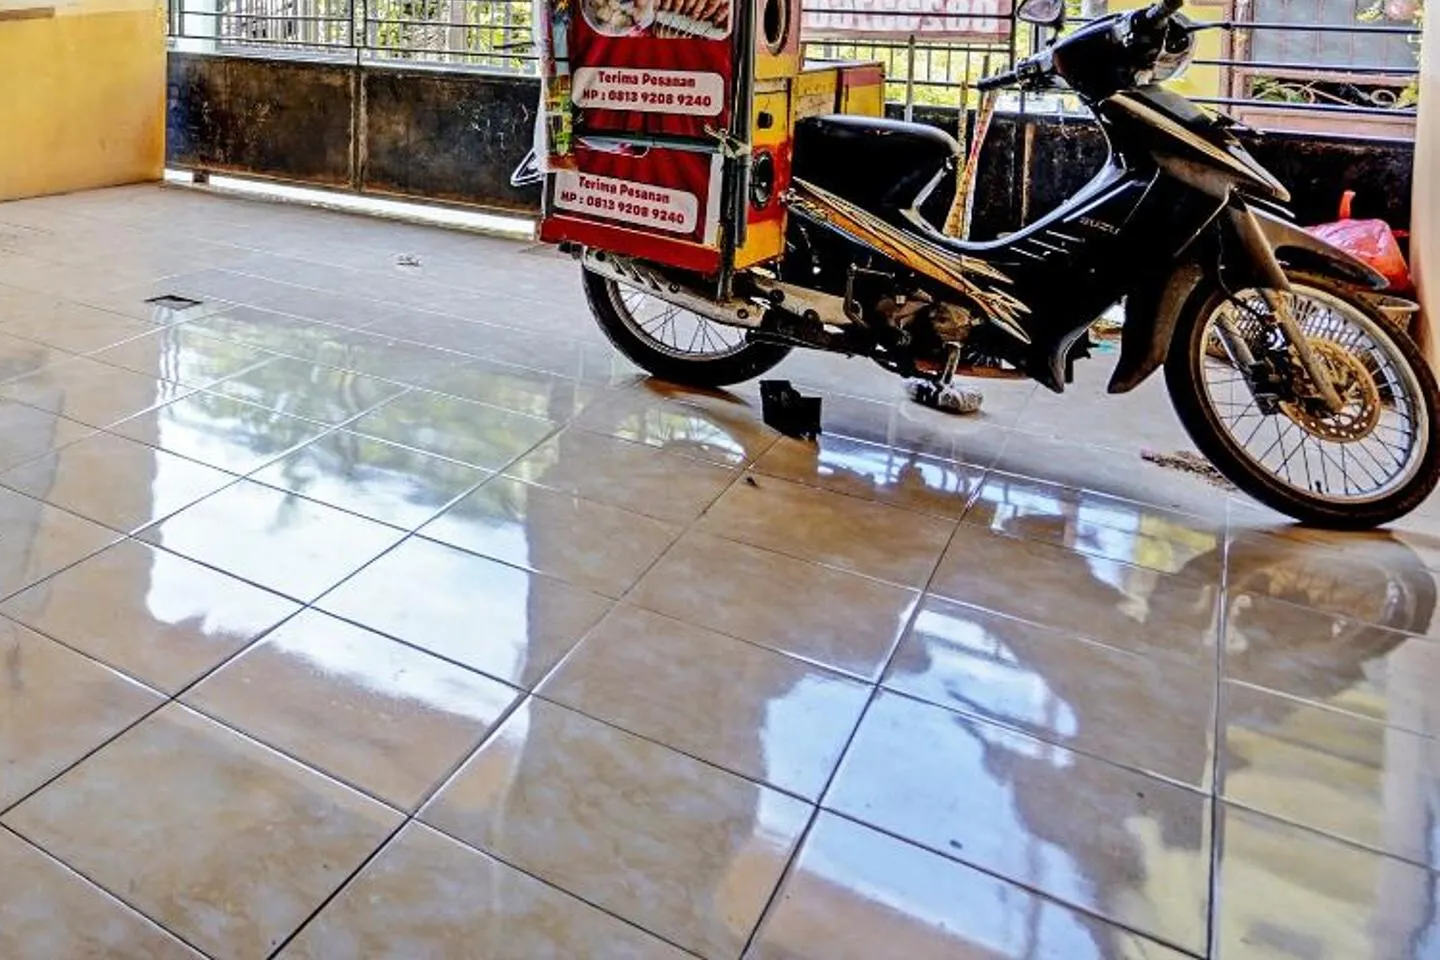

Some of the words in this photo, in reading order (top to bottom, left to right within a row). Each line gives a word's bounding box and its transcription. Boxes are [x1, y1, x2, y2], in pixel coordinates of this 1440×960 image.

[597, 70, 639, 87] Terima
[641, 72, 696, 88] Pesanan
[582, 89, 599, 100] HP
[609, 89, 638, 102] 0813
[640, 91, 675, 105] 9208
[677, 93, 712, 107] 9240
[578, 175, 617, 194] Terima
[619, 184, 670, 204] Pesanan
[560, 191, 577, 203] HP
[617, 202, 649, 217] 9208
[651, 207, 685, 224] 9240
